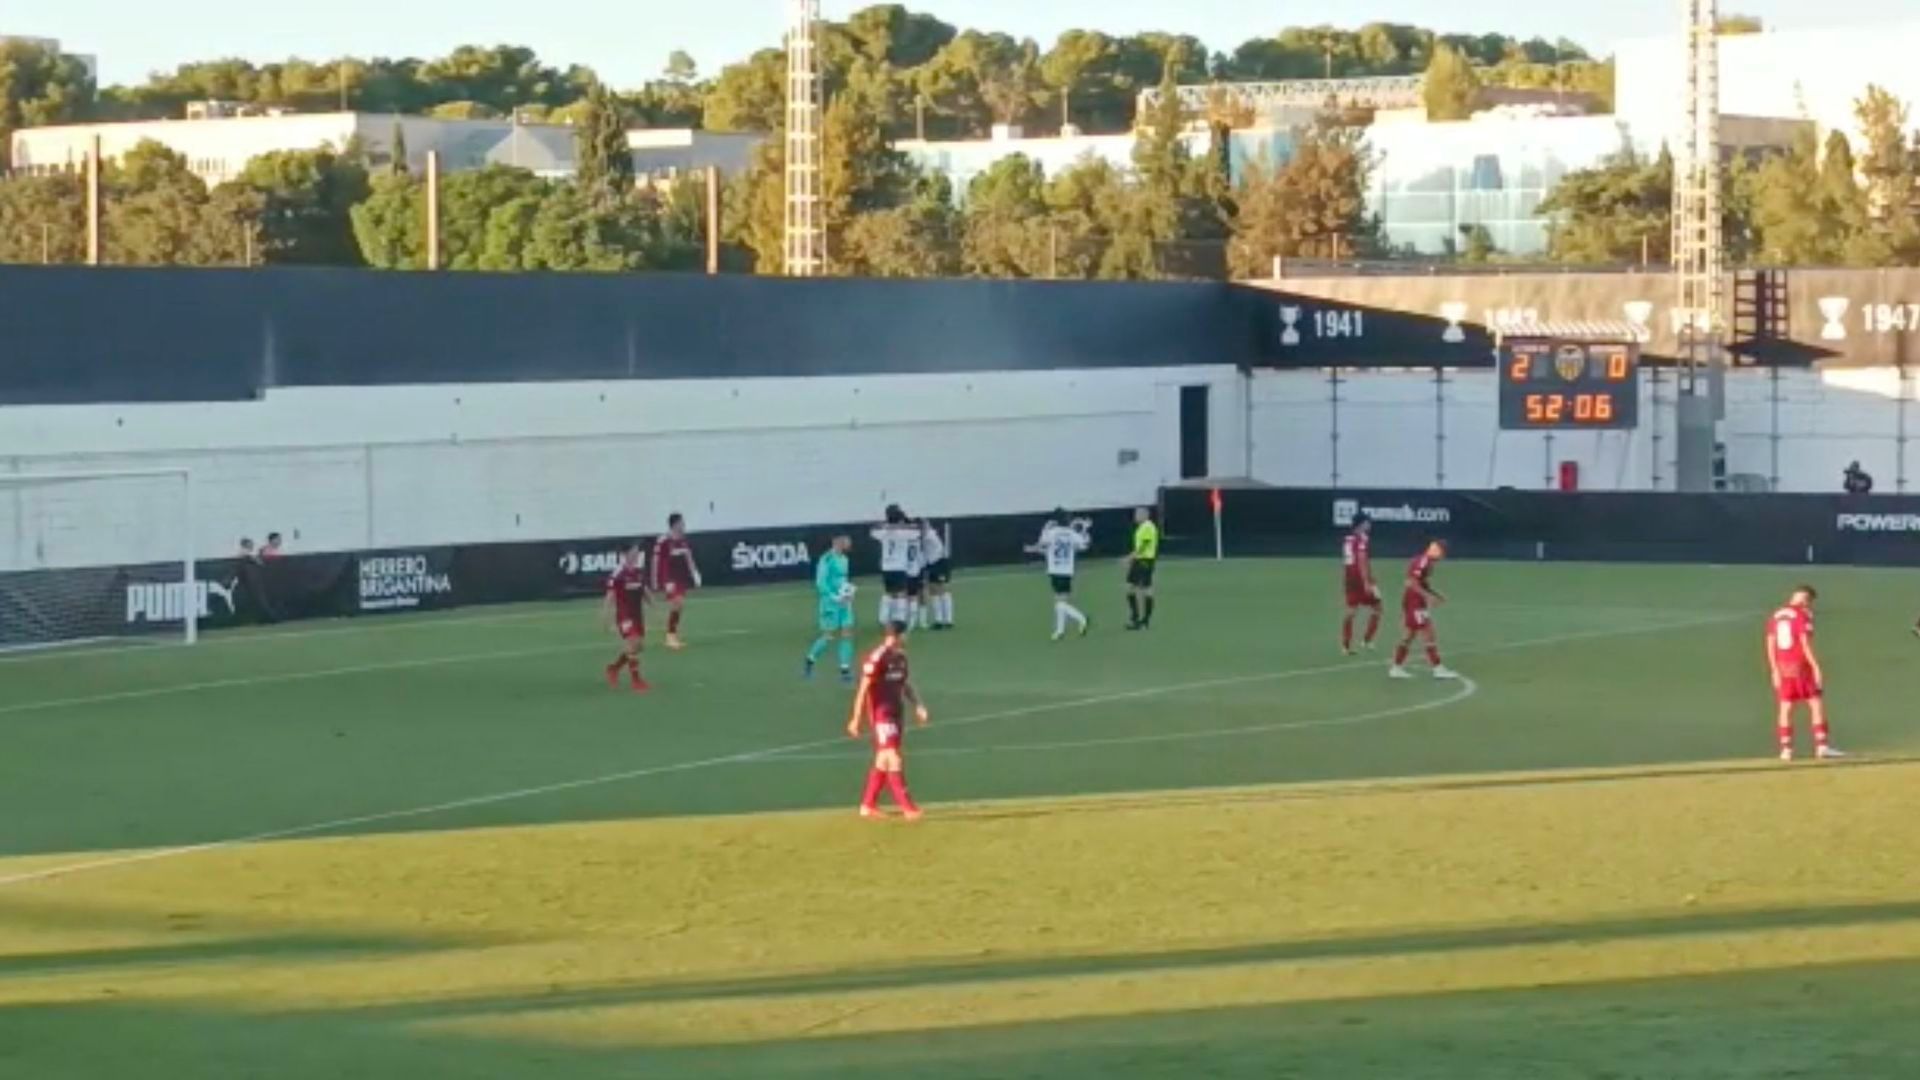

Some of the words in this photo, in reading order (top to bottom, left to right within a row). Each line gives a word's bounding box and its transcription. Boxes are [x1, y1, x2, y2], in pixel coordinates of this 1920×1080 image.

[1314, 310, 1363, 337] 1941
[1863, 303, 1920, 331] 1947
[1510, 353, 1530, 380] 2
[1608, 353, 1626, 379] 0
[1526, 394, 1612, 420] 52:06
[1836, 512, 1920, 531] POWER
[732, 541, 810, 570] ŠKODA
